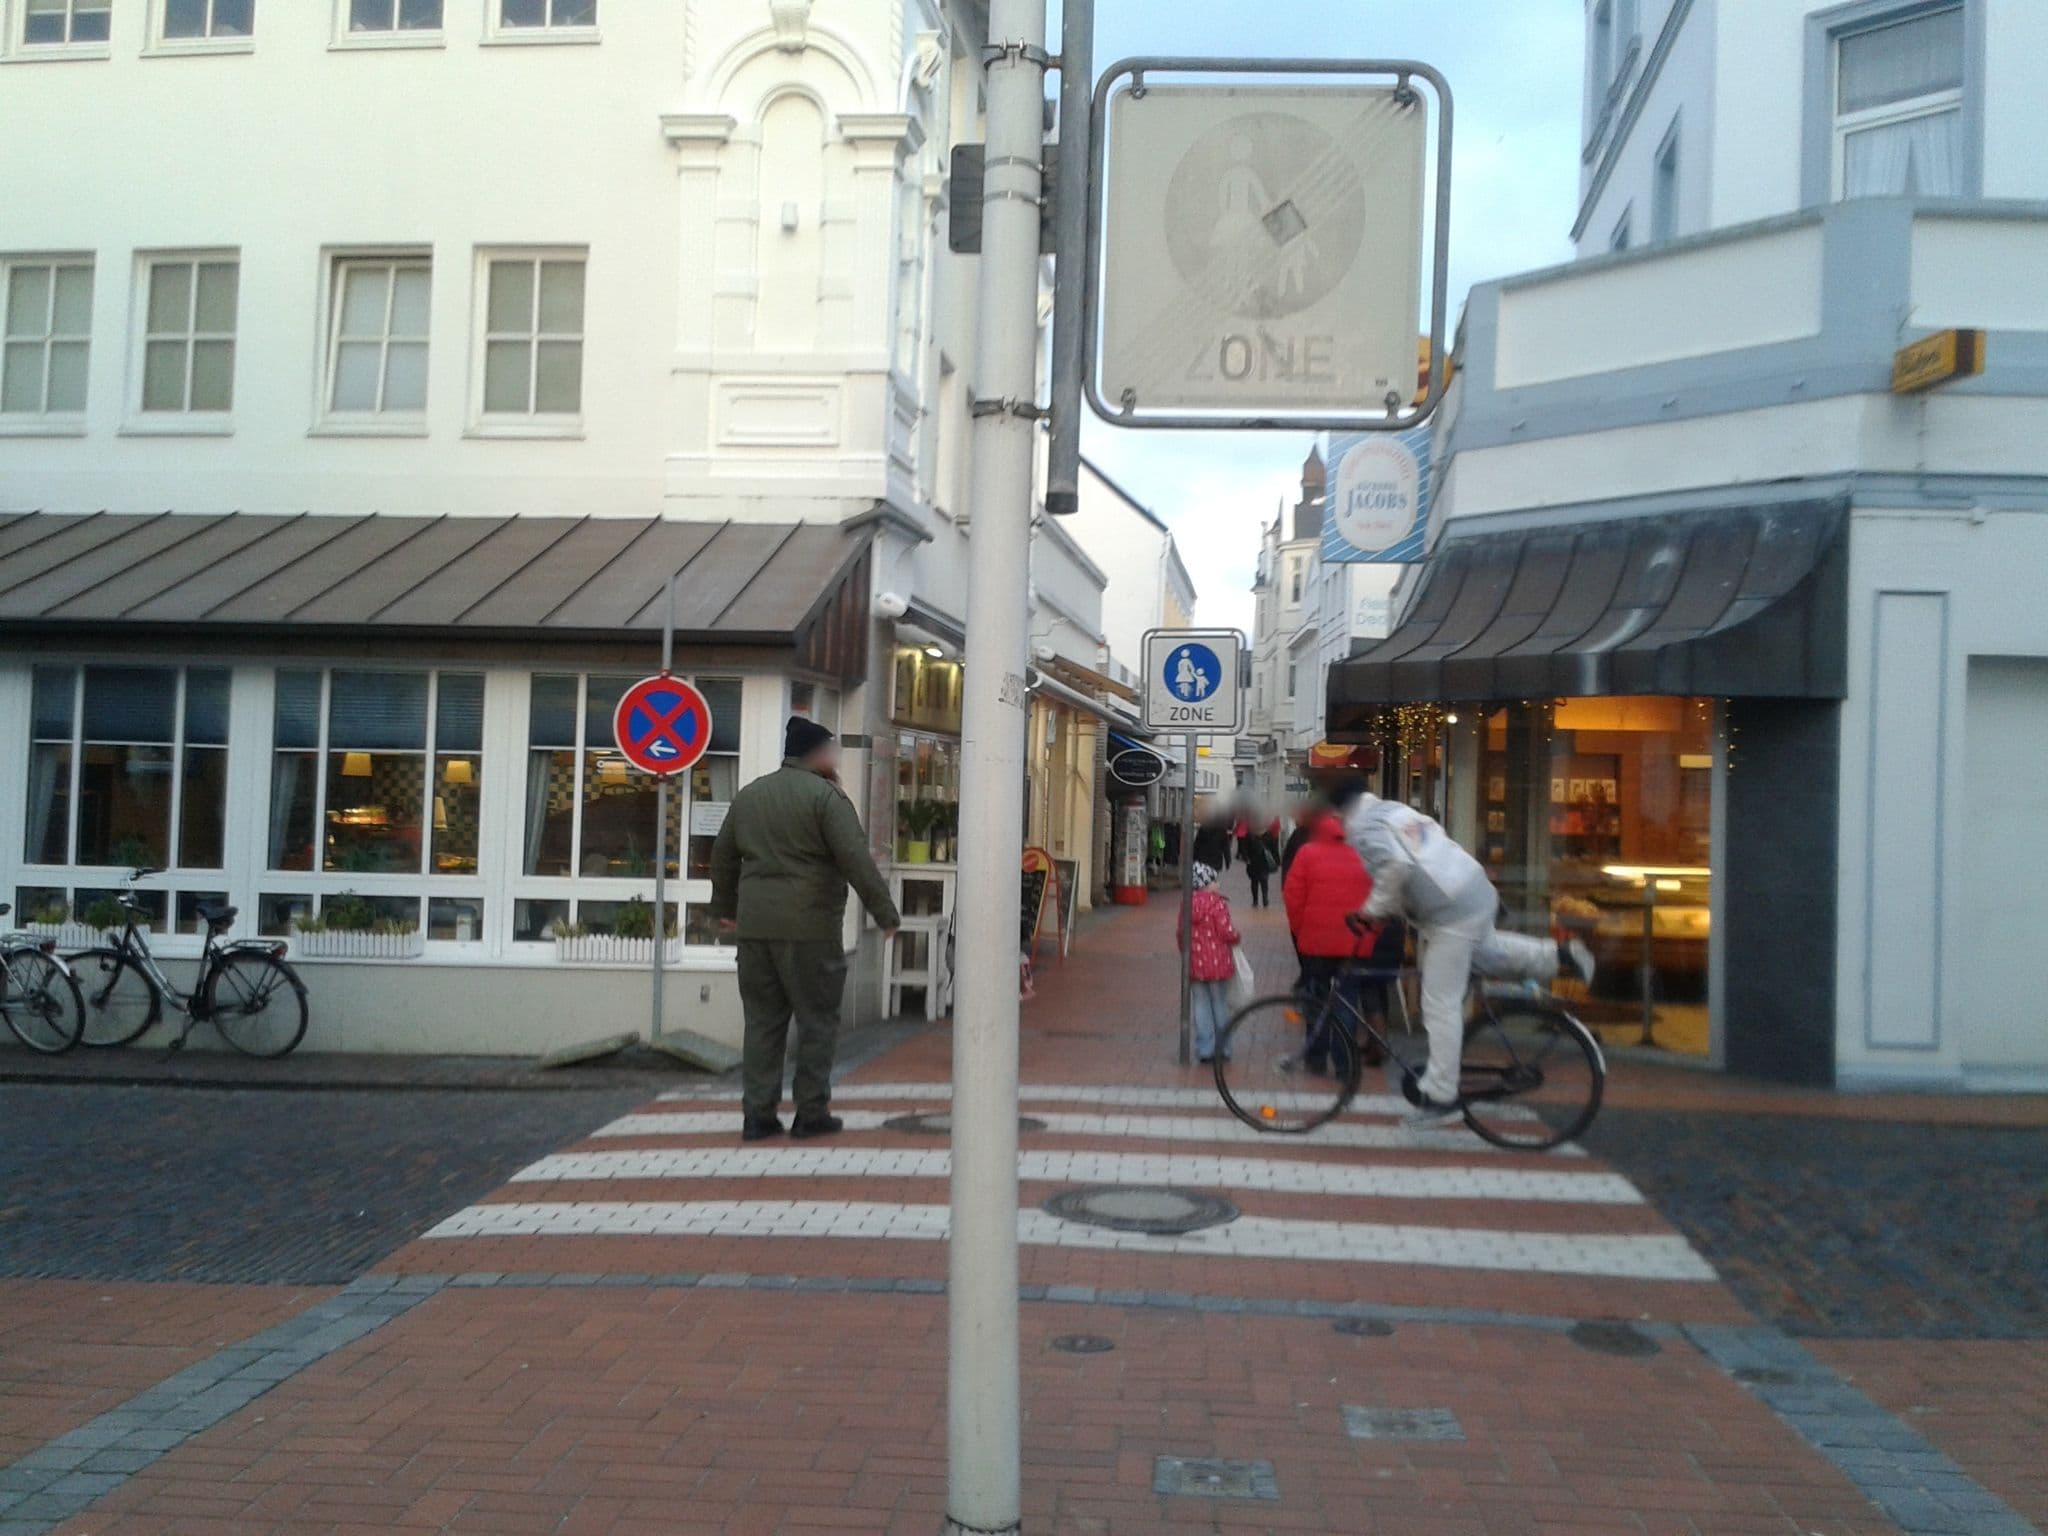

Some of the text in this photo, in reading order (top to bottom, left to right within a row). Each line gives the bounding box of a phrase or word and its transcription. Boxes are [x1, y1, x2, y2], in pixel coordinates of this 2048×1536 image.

[1184, 333, 1337, 383] ZONE
[1344, 488, 1408, 518] JACOBS
[1169, 707, 1214, 722] ZONE
